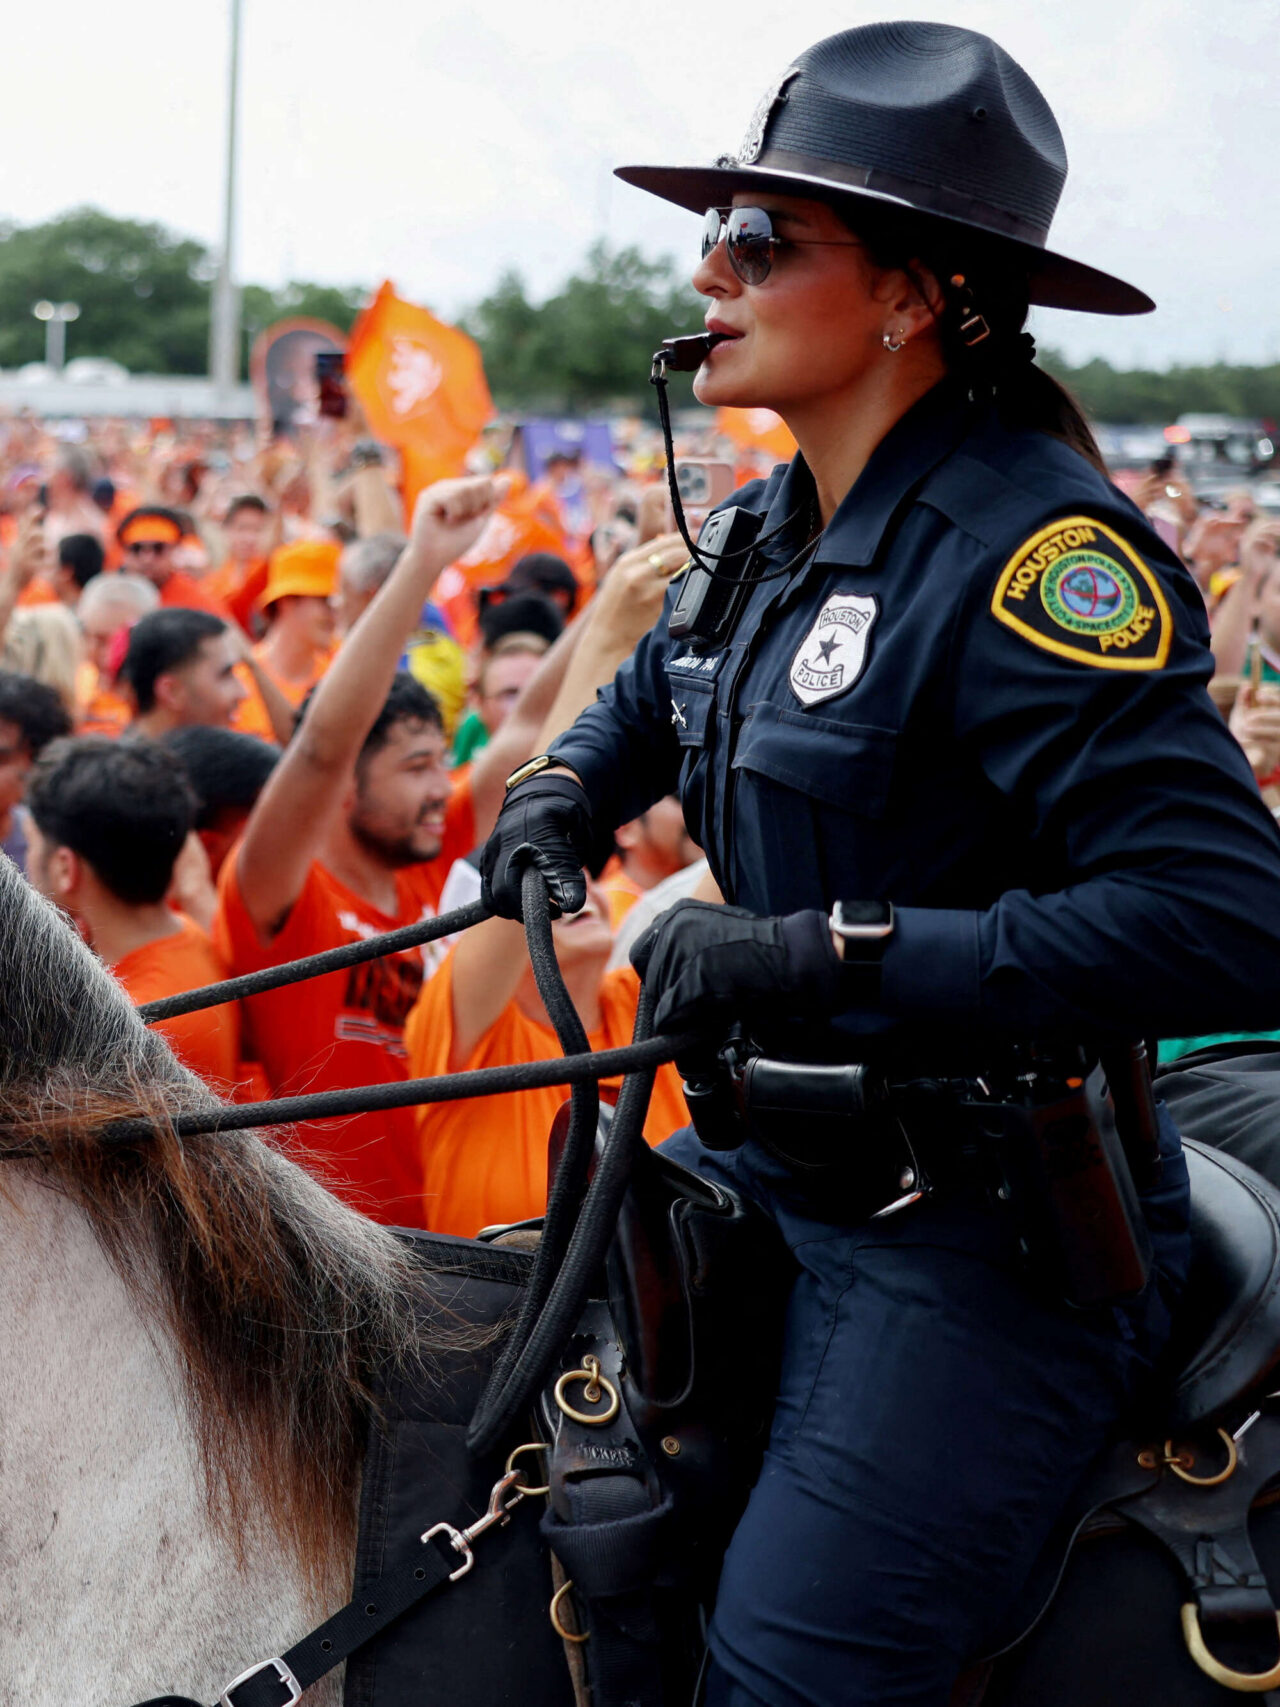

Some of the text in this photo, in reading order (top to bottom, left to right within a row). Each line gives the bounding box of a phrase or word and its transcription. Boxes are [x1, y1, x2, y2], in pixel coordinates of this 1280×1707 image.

[1006, 526, 1097, 600] HOUSTON
[821, 609, 863, 628] HOUSTON
[1099, 605, 1156, 653] POLICE
[798, 667, 839, 687] POLICE
